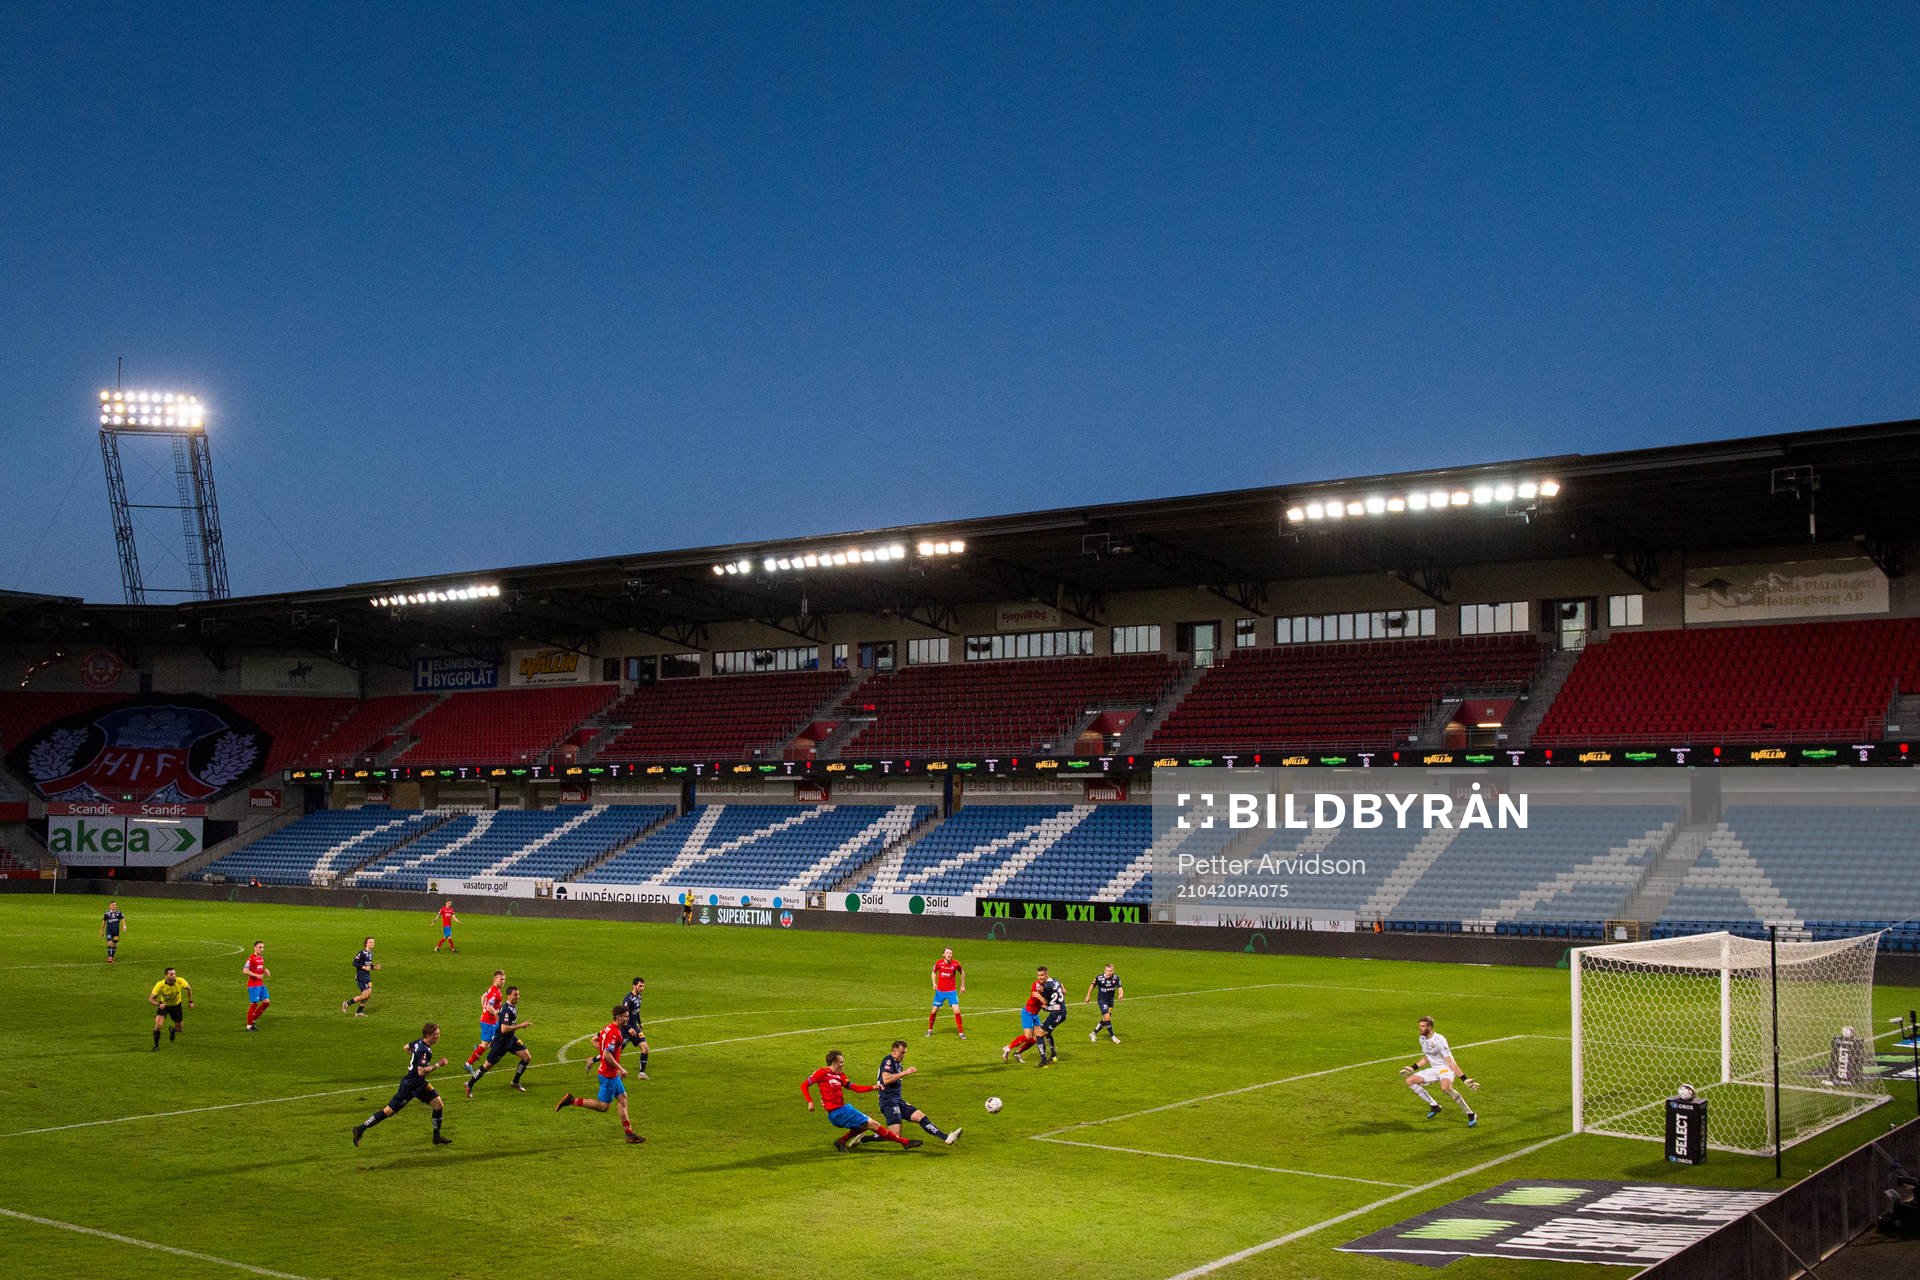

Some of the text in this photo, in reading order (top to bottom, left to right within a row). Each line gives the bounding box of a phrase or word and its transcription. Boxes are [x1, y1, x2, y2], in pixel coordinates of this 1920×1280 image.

[1844, 591, 1864, 602] AB
[432, 668, 493, 687] BYGGPLÅT
[1089, 788, 1117, 801] PUMA
[68, 803, 115, 815] Scandic
[141, 803, 187, 816] Scandic
[50, 819, 150, 853] akea
[462, 880, 509, 893] vasatorp.golf
[861, 893, 884, 906] Solid
[925, 895, 949, 908] Solid
[717, 907, 772, 926] SUPERETTAN
[1258, 912, 1313, 931] MÖBLER
[1048, 987, 1064, 1005] 23
[1675, 1113, 1689, 1156] SELECT
